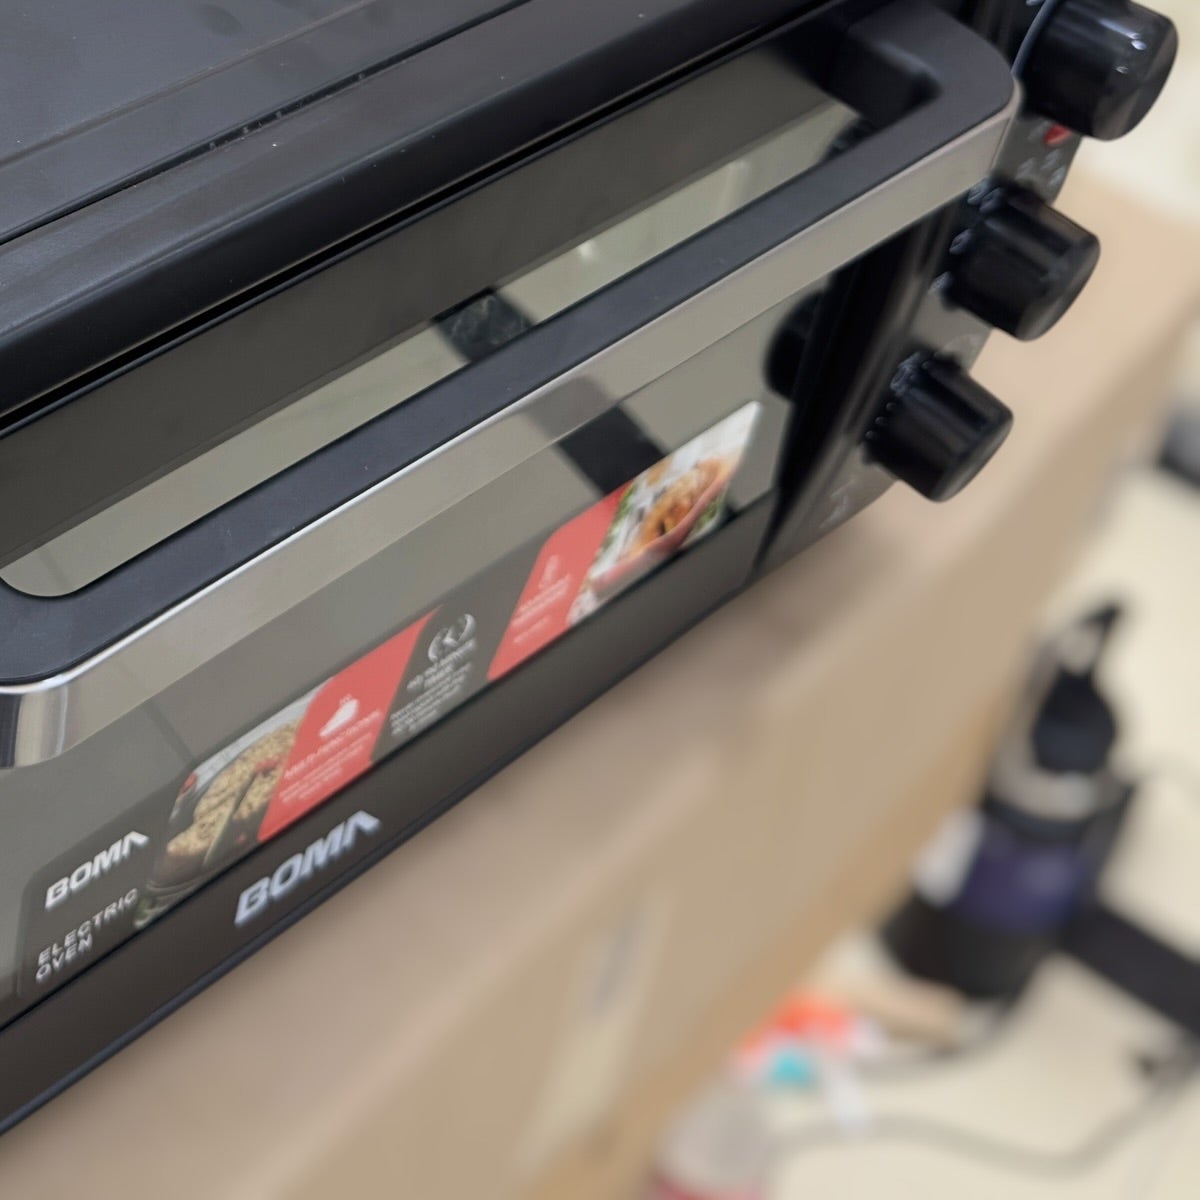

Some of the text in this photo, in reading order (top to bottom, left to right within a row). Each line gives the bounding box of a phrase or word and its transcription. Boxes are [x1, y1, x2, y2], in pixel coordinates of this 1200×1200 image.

[45, 831, 149, 911] BOMA
[234, 810, 381, 927] BOMA
[35, 933, 93, 982] OVEN
[38, 888, 137, 966] ELECTRIC
